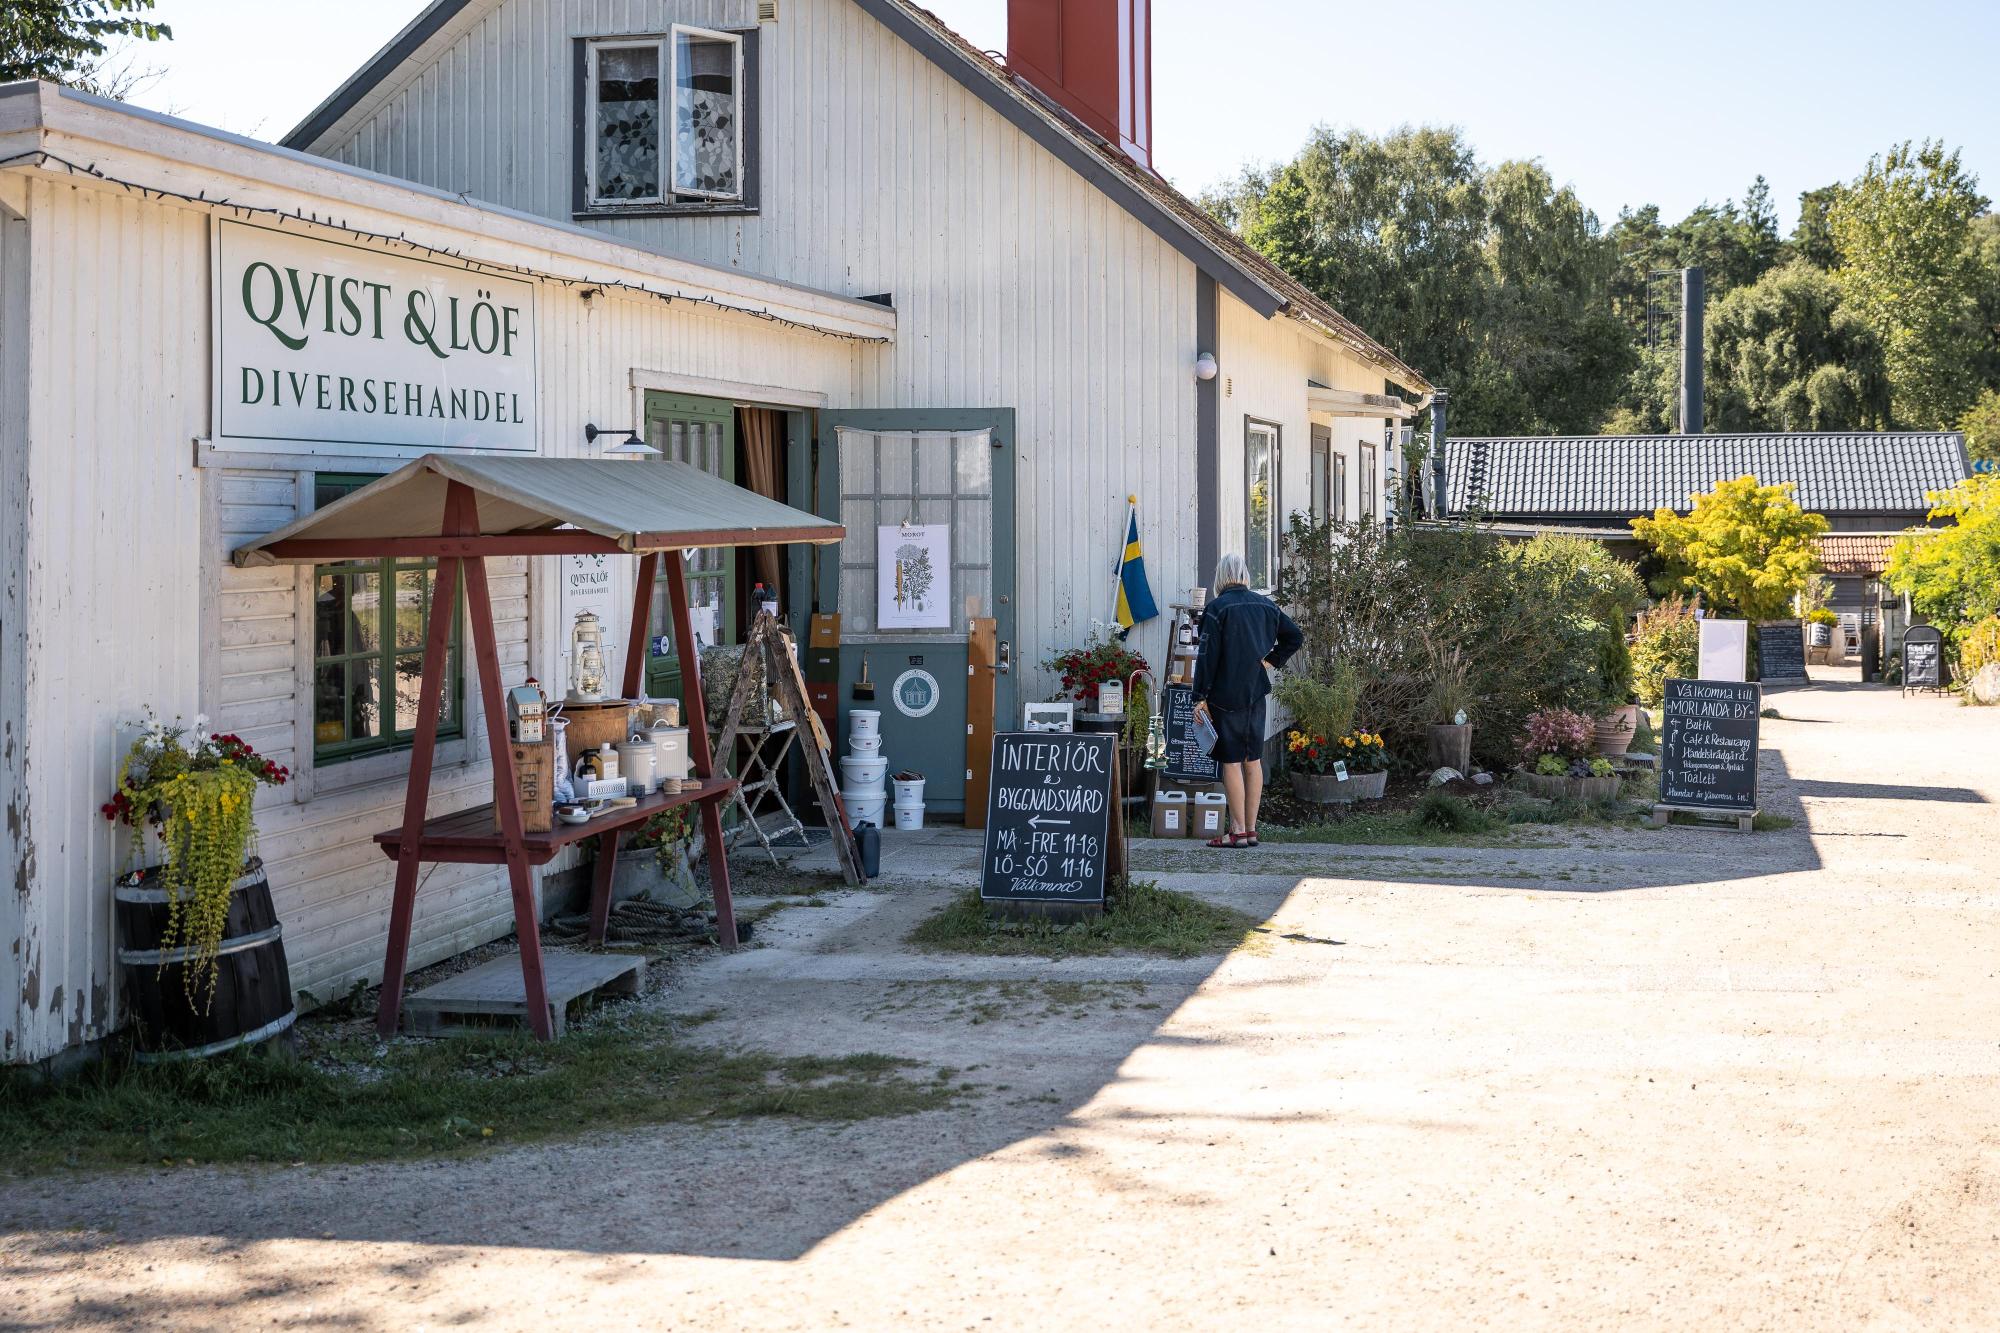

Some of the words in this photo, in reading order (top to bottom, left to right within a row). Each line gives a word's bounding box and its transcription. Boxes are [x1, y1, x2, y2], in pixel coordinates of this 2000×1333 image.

[242, 262, 391, 350] QVIST
[403, 287, 449, 359] &
[450, 289, 519, 356] LÖF
[241, 367, 524, 423] DIVERSEHANDEL
[570, 573, 590, 587] QVIST
[590, 573, 597, 584] &
[597, 571, 608, 582] LÖF
[1677, 683, 1733, 699] Välkomna
[1738, 689, 1752, 700] till
[1670, 701, 1730, 717] MORLANDA
[1734, 704, 1750, 718] BY
[1683, 732, 1702, 745] Café
[1704, 734, 1710, 744] &
[1711, 733, 1751, 752] Restaurang
[1002, 739, 1104, 773] INTERIÖR
[1043, 775, 1061, 784] &
[1680, 771, 1717, 784] Toalett
[998, 785, 1103, 813] BYGGNADSVÅRD
[1666, 787, 1695, 798] Hundar
[1696, 790, 1703, 798] är
[1064, 834, 1098, 857] 11-18
[1060, 858, 1093, 878] 11-16
[1011, 877, 1083, 893] Välkomna
